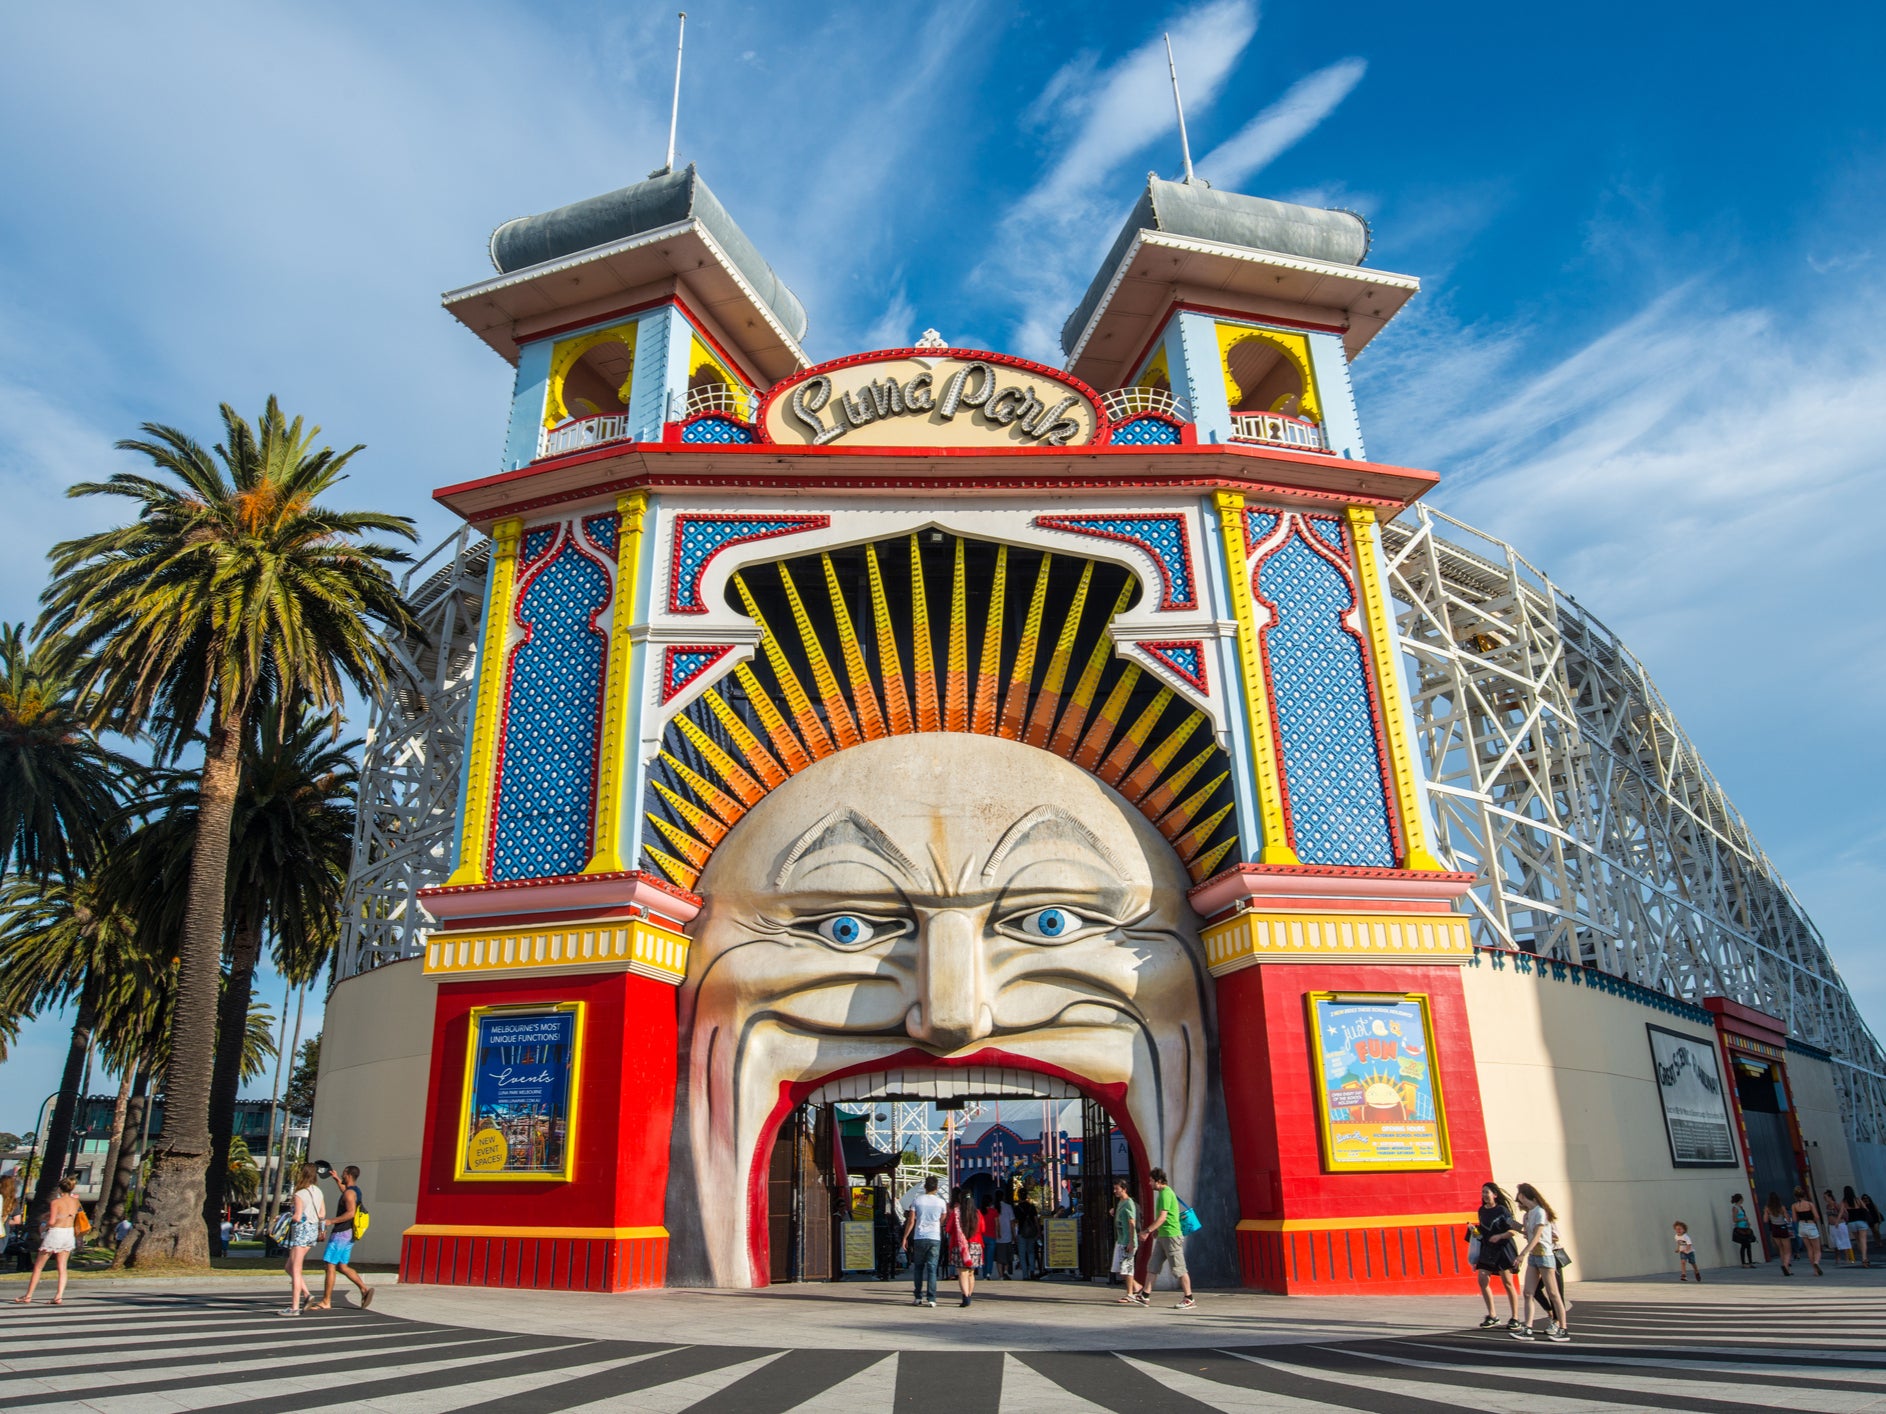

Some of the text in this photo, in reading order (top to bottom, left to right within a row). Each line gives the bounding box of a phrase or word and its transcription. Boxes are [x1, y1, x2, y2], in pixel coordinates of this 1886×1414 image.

[793, 361, 1080, 445] Luna Park
[491, 1022, 561, 1033] MELBOURNE'S MOST
[490, 1032, 561, 1043] UNIQUE FUNCTIONS!
[1341, 1017, 1372, 1051] just
[1354, 1038, 1398, 1064] FUN
[488, 1067, 555, 1086] Events
[479, 1136, 495, 1146] NEW
[476, 1145, 499, 1156] EVENT
[1118, 1143, 1127, 1153] A
[474, 1154, 502, 1167] SPACES!
